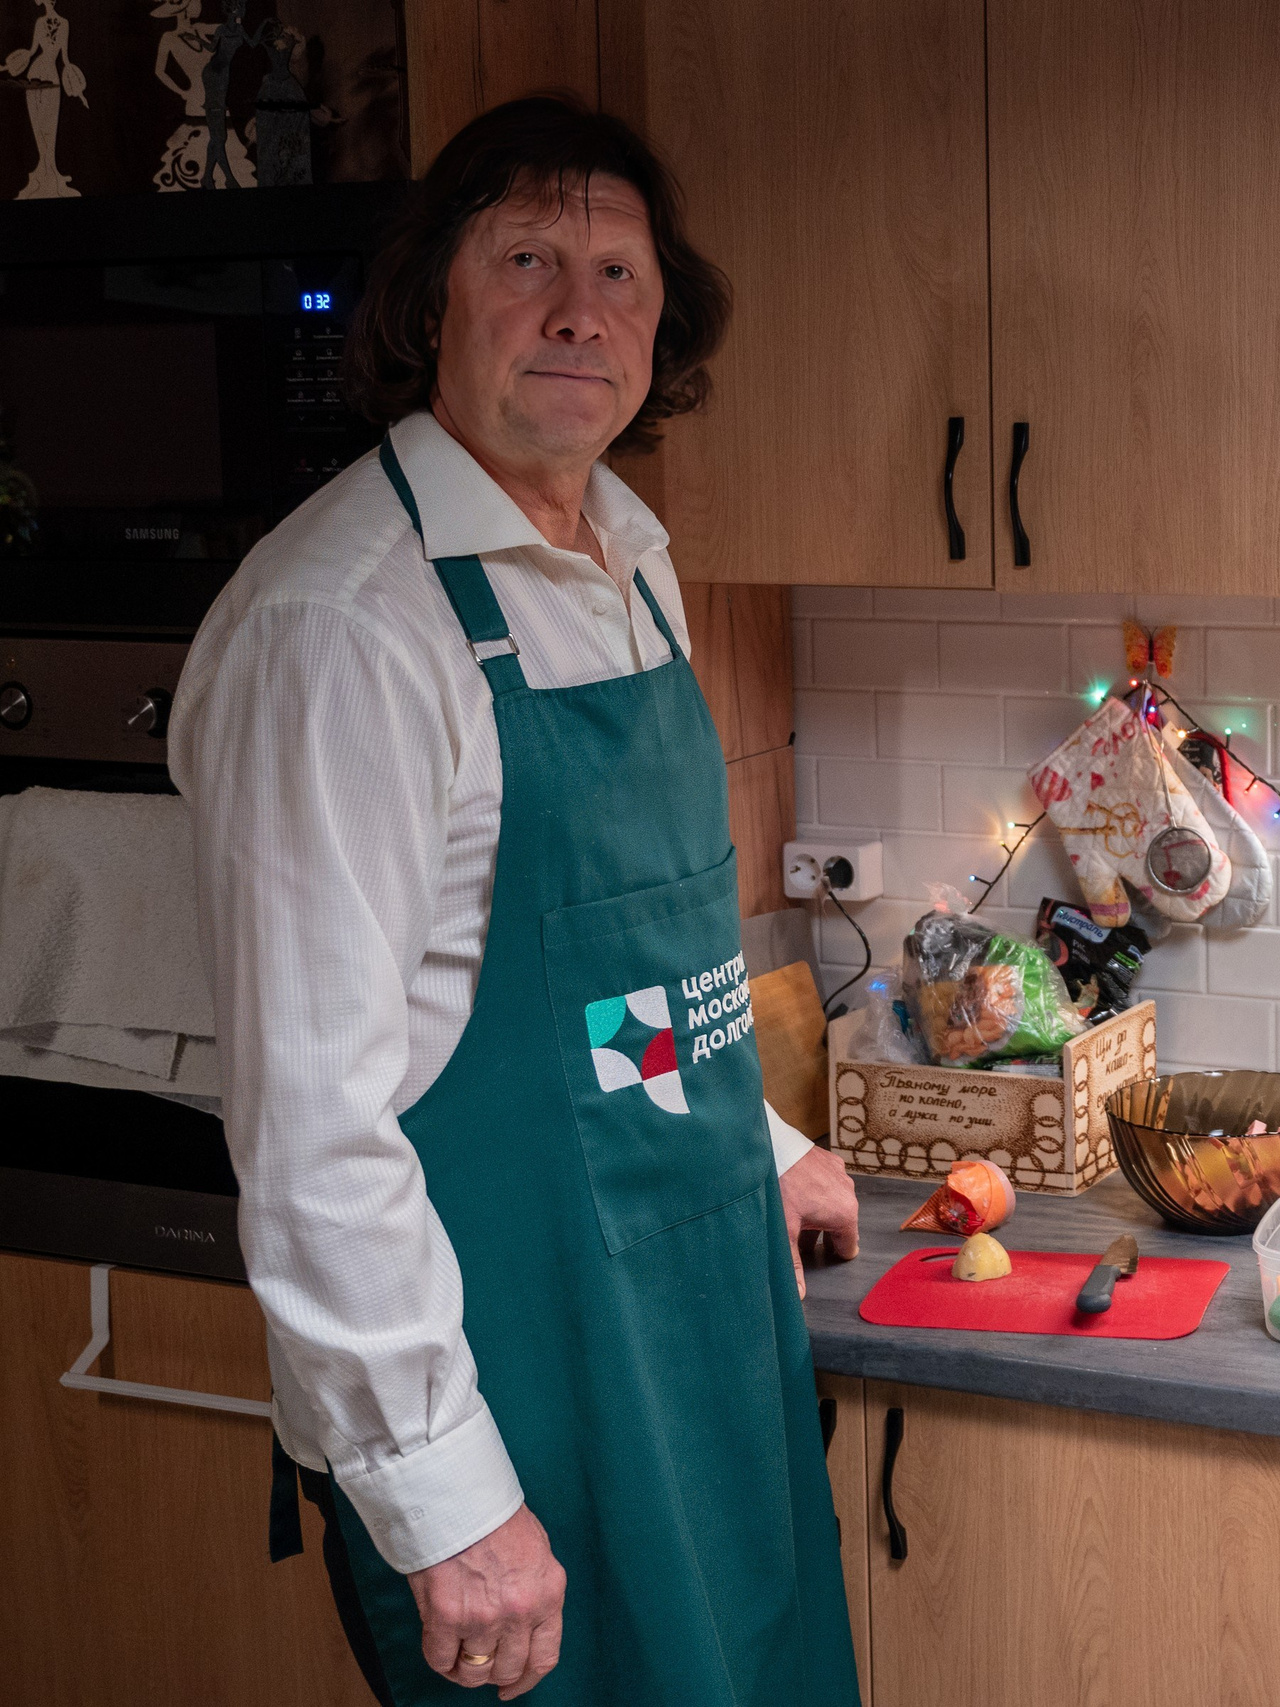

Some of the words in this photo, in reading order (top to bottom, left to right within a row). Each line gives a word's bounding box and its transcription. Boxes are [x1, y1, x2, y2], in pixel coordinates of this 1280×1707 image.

[124, 527, 180, 540] SAMSUNG
[1056, 909, 1104, 938] Мистраль
[688, 971, 751, 1030] моско
[692, 1004, 754, 1064] долго
[1095, 1036, 1112, 1062] Щи
[1114, 1029, 1127, 1056] да
[879, 1070, 951, 1096] Пьяному
[958, 1084, 998, 1098] море
[888, 1108, 897, 1118] а
[948, 1113, 964, 1124] по
[899, 1093, 914, 1104] по
[918, 1095, 967, 1111] колено,
[154, 1225, 216, 1243] DARINA
